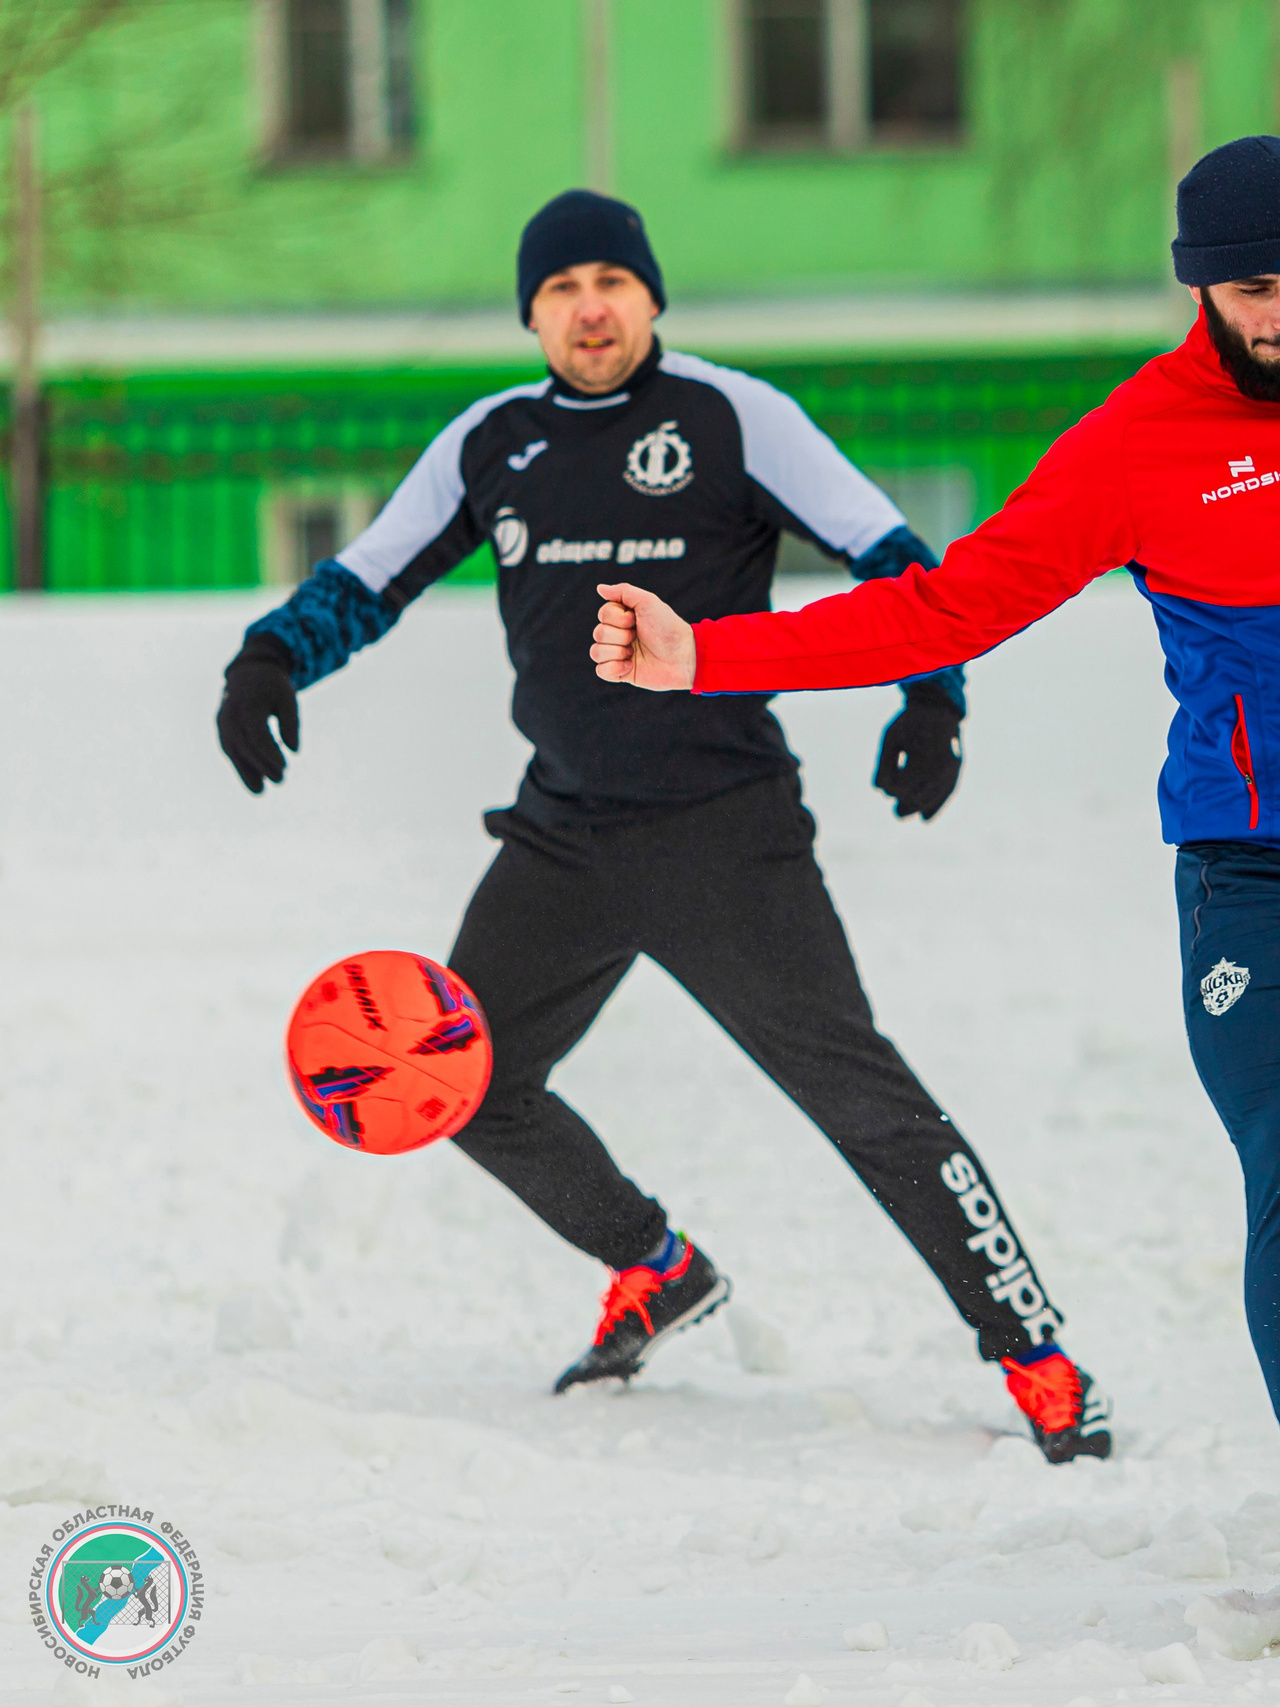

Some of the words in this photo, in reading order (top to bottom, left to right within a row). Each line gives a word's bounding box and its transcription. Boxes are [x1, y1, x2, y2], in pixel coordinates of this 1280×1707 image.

[537, 538, 613, 564] общее
[617, 538, 685, 564] дело
[940, 1151, 1061, 1345] adidas
